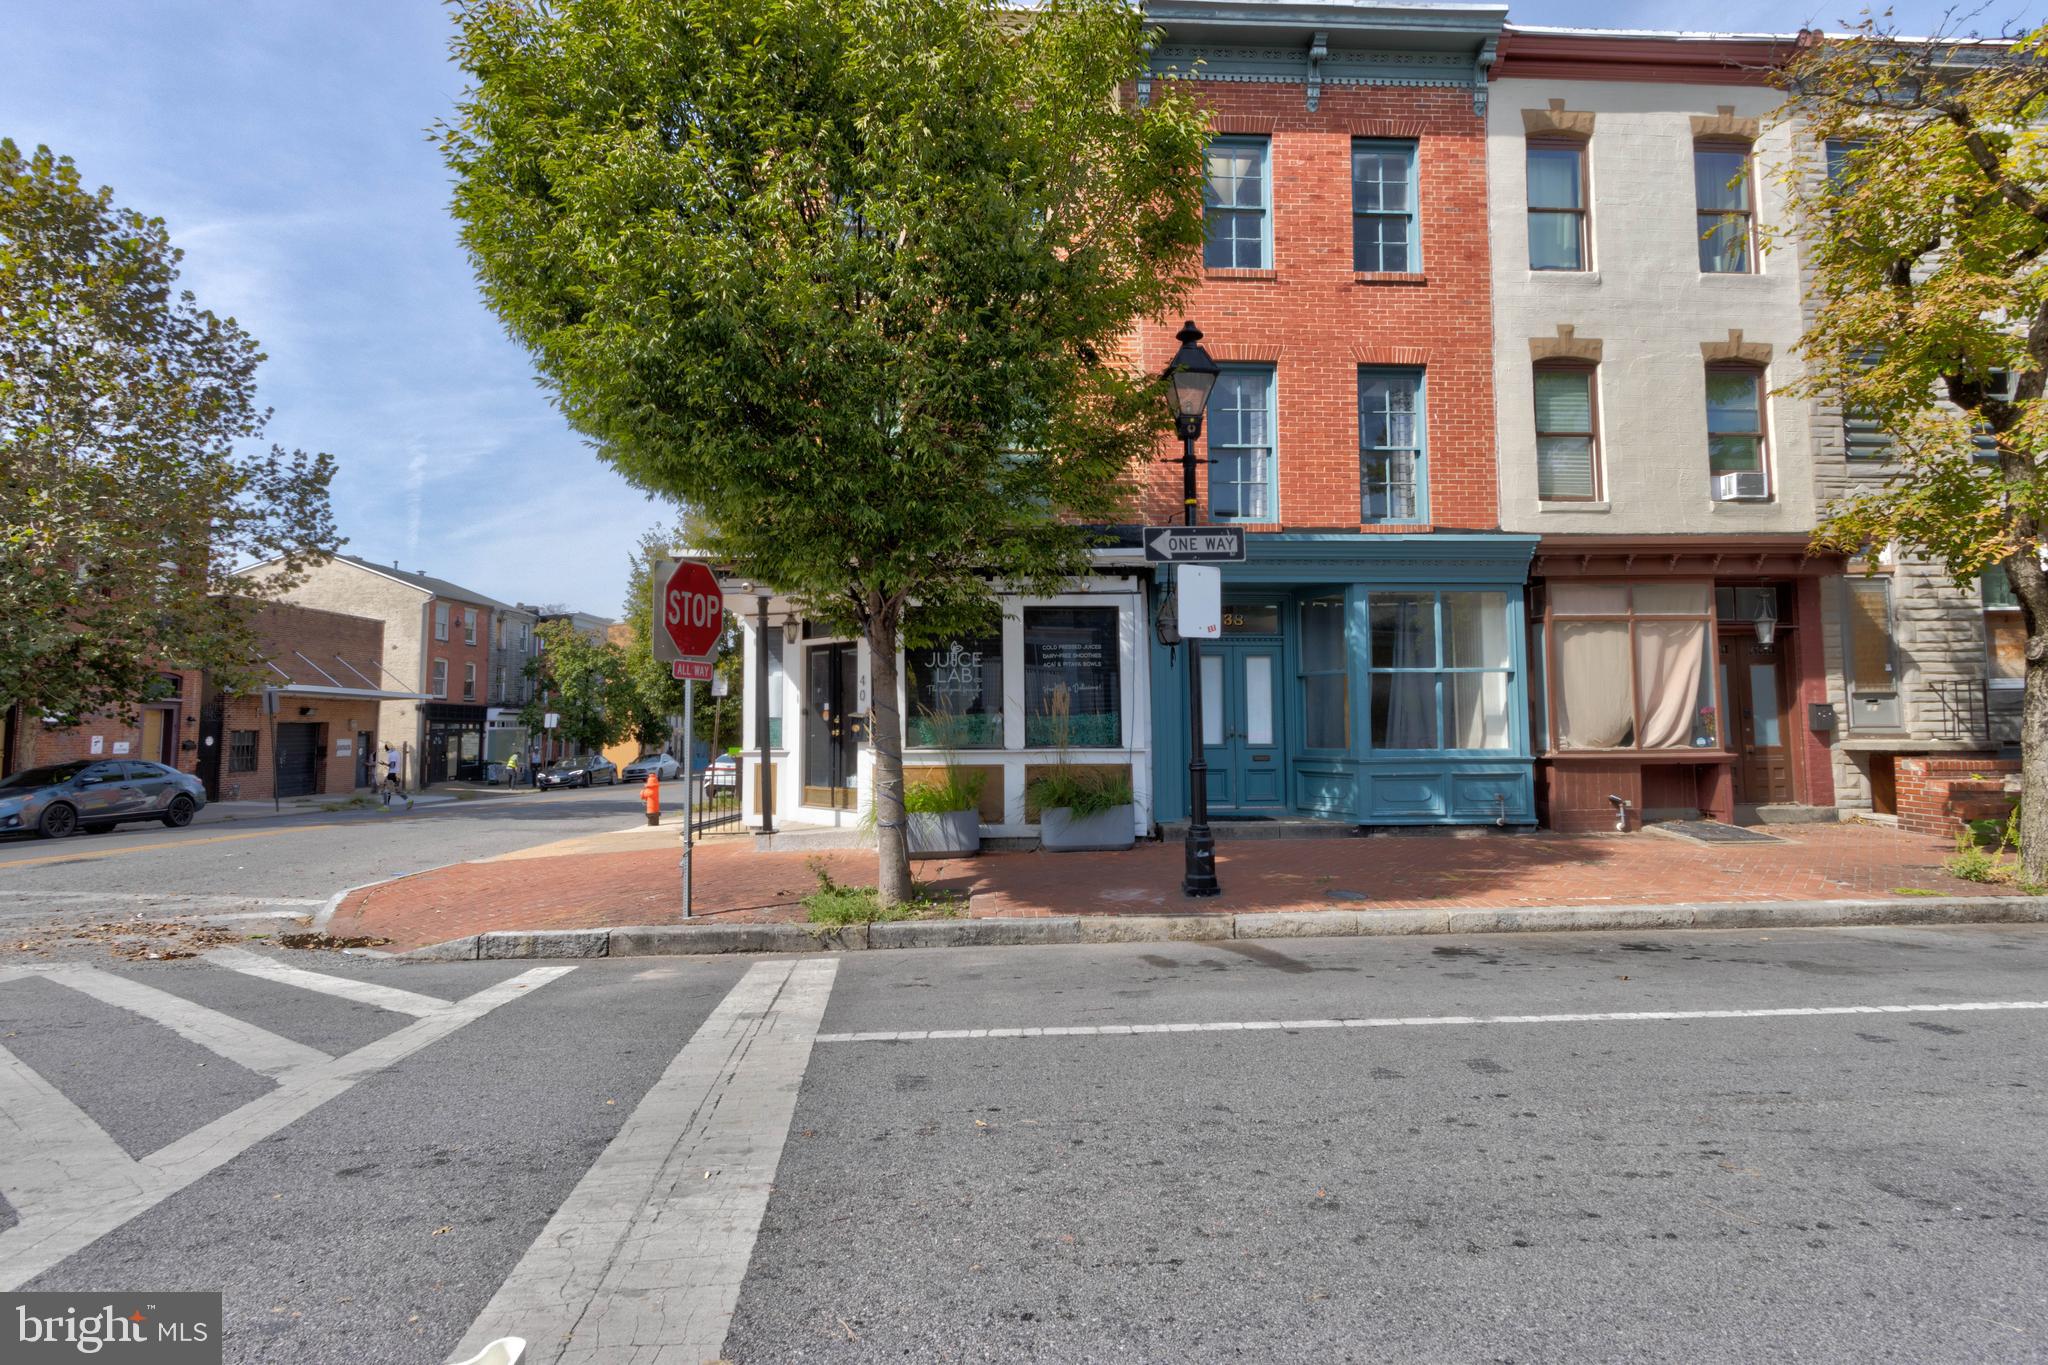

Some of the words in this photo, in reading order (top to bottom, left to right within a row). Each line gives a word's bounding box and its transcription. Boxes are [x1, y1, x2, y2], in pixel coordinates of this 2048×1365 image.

[1168, 537, 1198, 551] ONE
[1204, 537, 1235, 551] WAY
[668, 589, 720, 629] STOP
[1223, 613, 1244, 626] 38
[924, 650, 983, 668] JUICE
[677, 665, 691, 676] ALL
[693, 665, 709, 677] WAY
[936, 668, 973, 683] LAB
